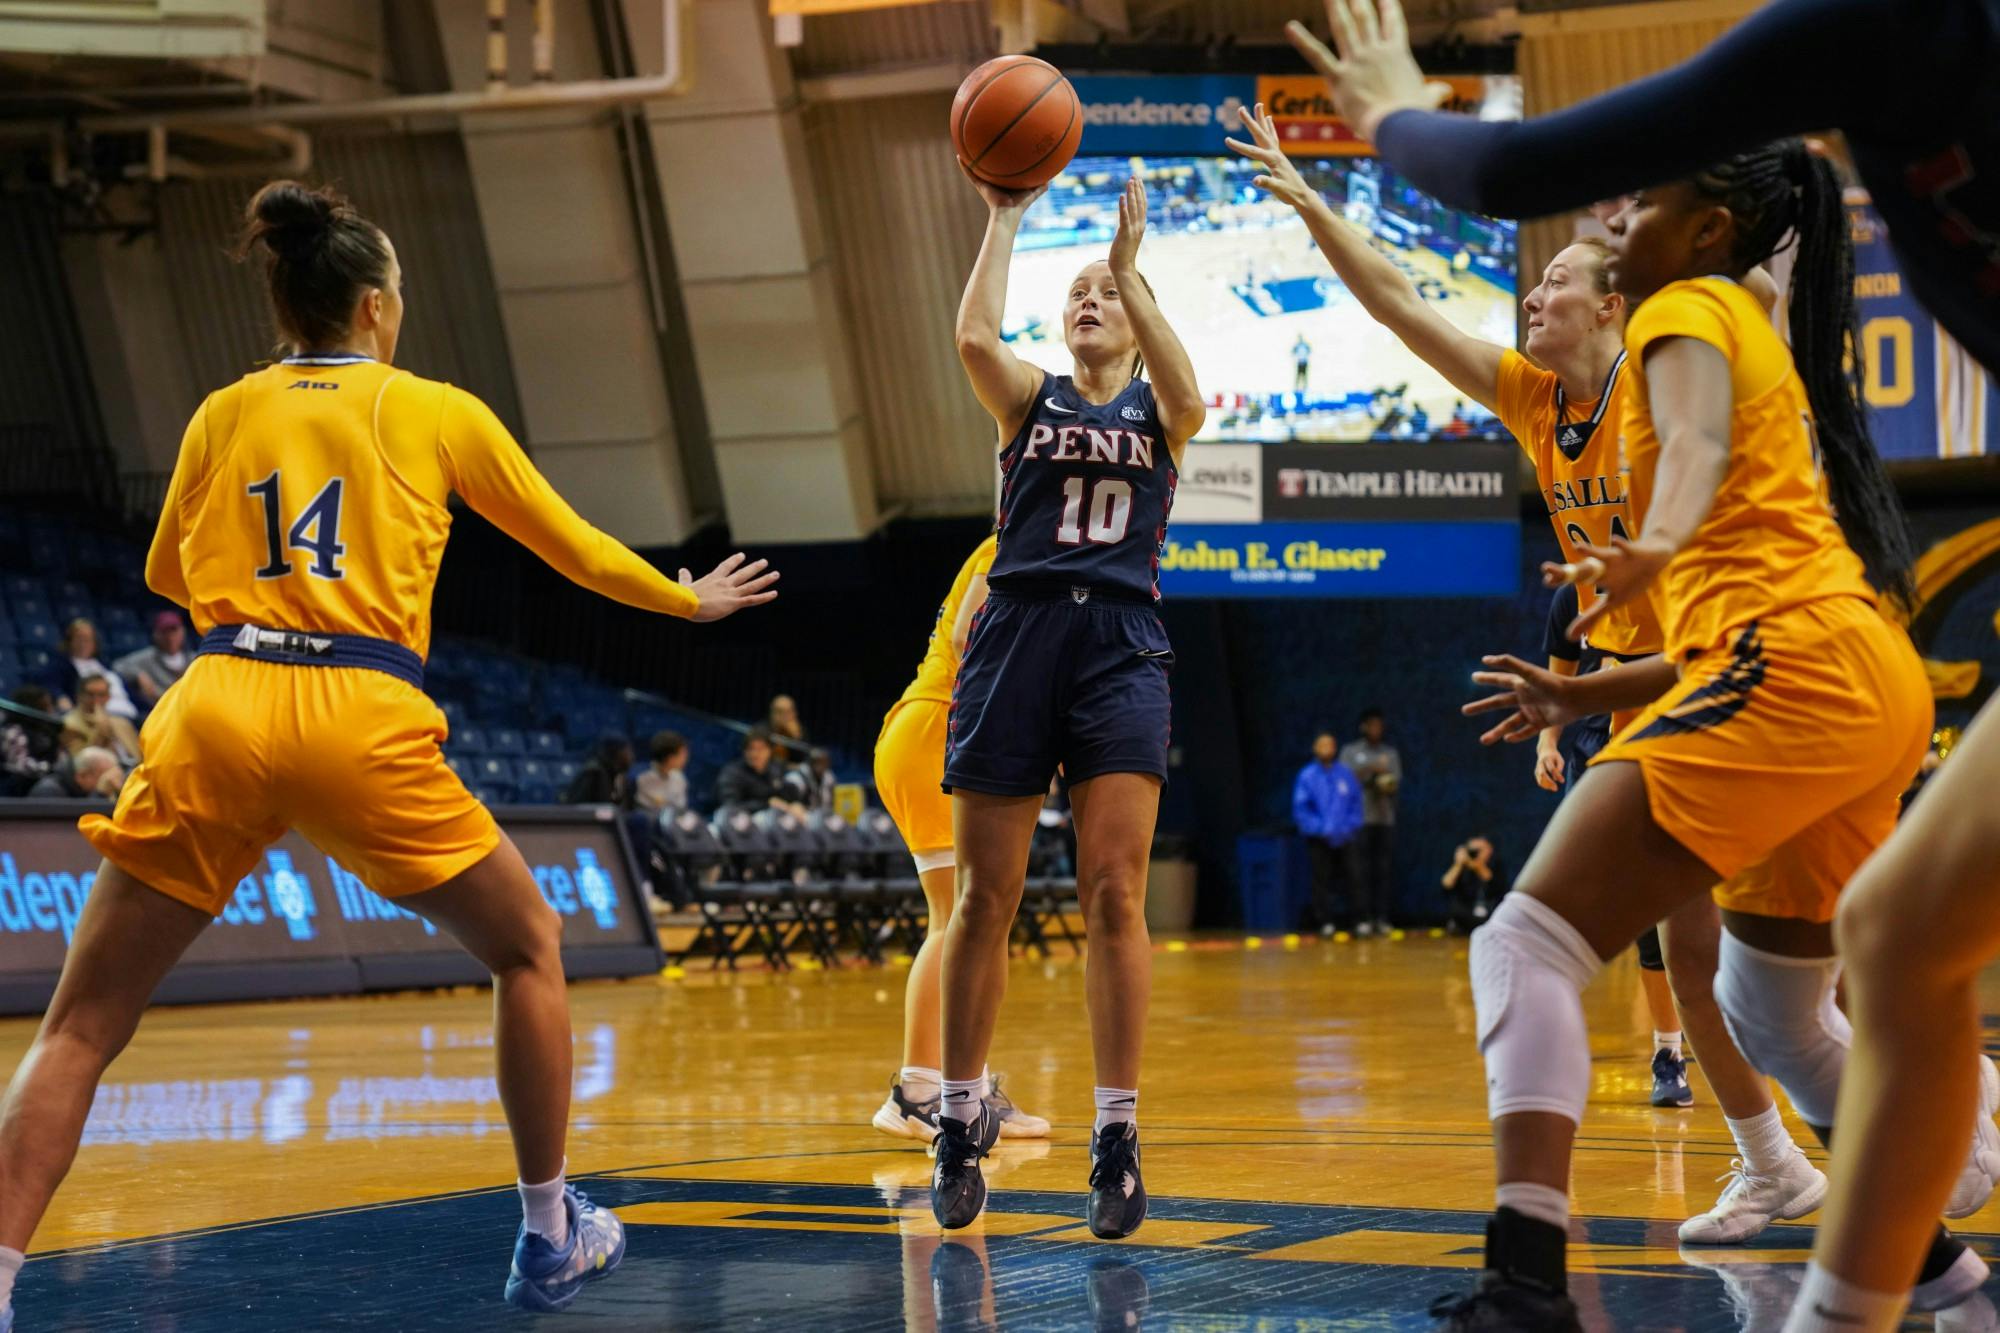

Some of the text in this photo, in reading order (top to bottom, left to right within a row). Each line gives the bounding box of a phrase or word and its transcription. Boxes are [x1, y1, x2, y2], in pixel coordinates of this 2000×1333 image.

[1022, 424, 1155, 470] PENN
[1304, 470, 1400, 497] TEMPLE
[1404, 470, 1503, 497] HEALTH
[247, 468, 345, 580] 14
[1056, 476, 1135, 546] 10
[1160, 540, 1386, 571] John E. Glaser
